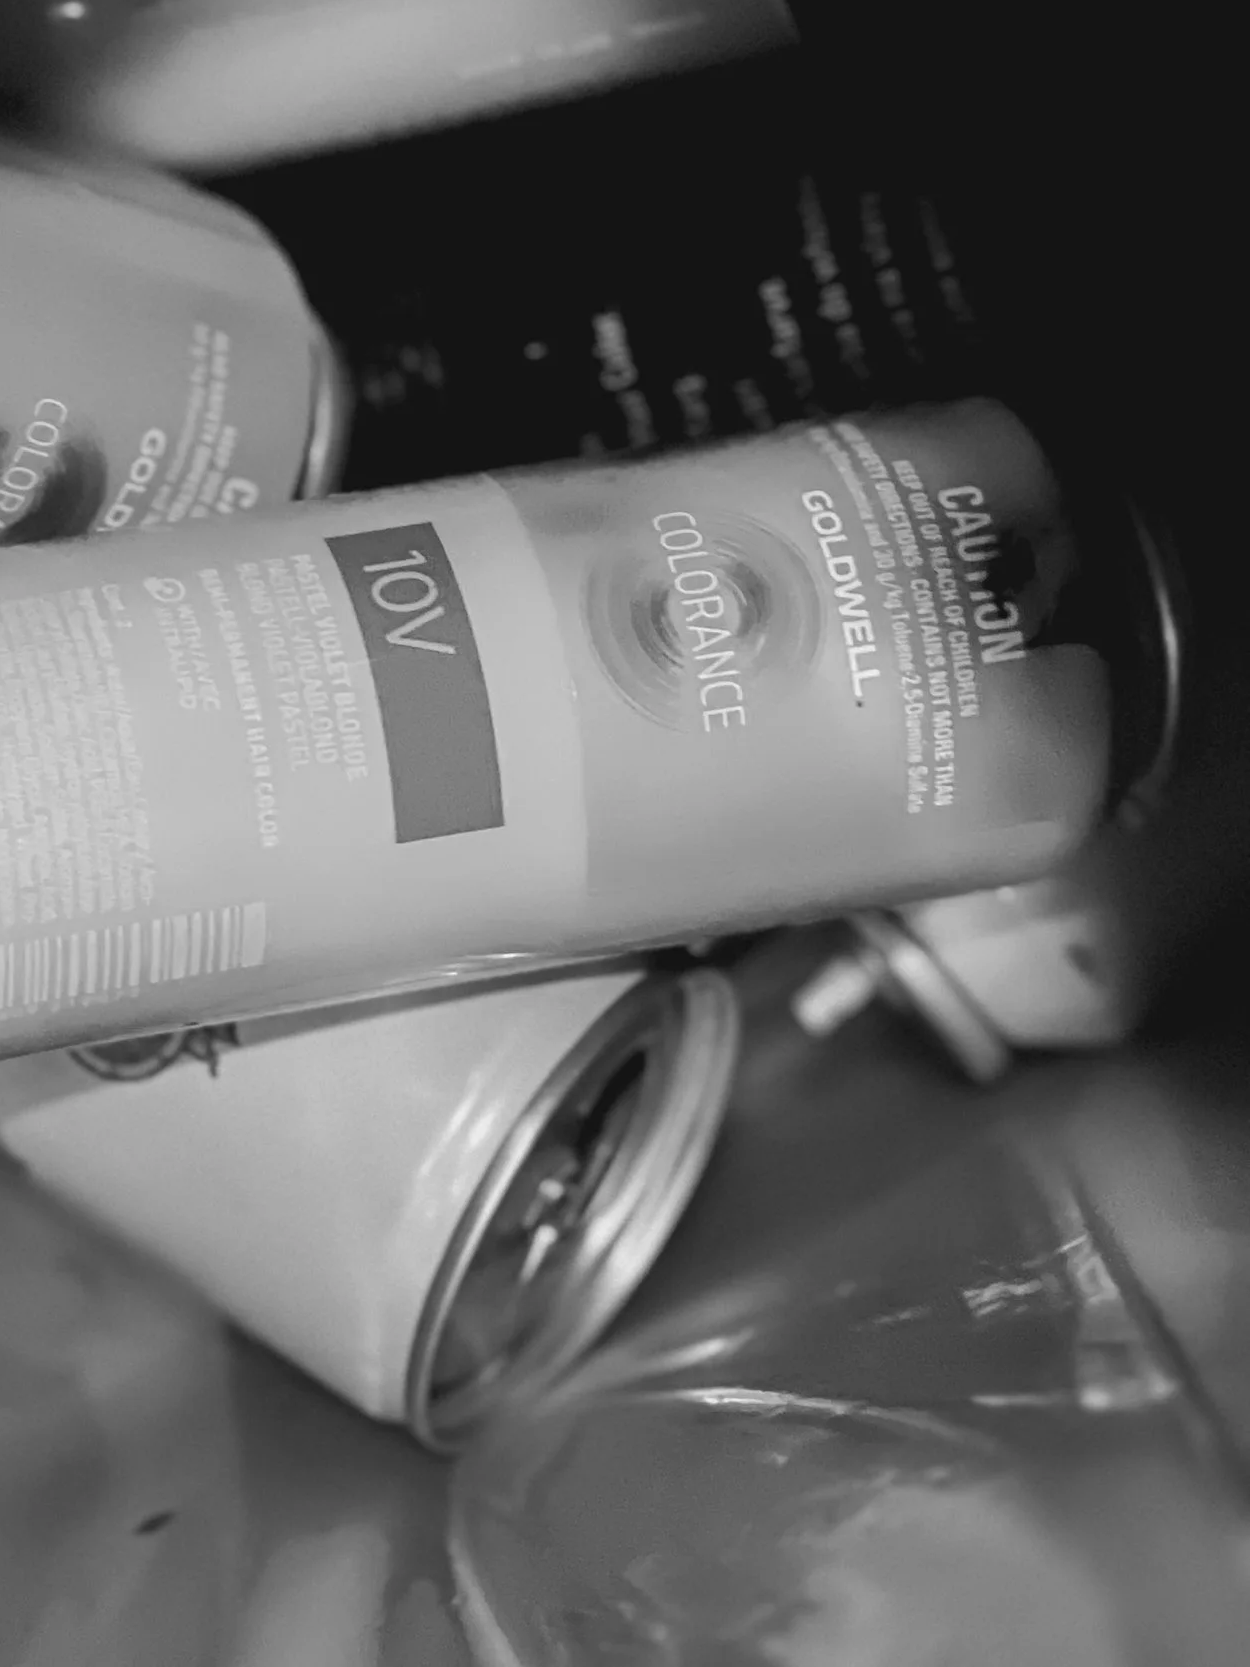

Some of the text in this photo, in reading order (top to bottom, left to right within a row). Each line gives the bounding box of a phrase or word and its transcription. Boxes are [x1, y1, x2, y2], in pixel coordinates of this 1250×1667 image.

[100, 427, 165, 531] GOLD
[908, 492, 935, 520] OUT
[919, 523, 944, 541] OF
[361, 548, 456, 656] 10V
[928, 547, 960, 601] REACH
[936, 486, 1027, 663] CAUON
[653, 510, 747, 732] COLORANCE
[910, 578, 945, 667] CONTAINS
[943, 603, 964, 626] OF
[236, 563, 310, 772] BLOND VIOLET PASTEL
[291, 554, 369, 781] PASTEL VIOLET BLONDE
[928, 669, 951, 705] NOT
[948, 629, 979, 718] CHILDREN
[246, 727, 271, 778] HAIR
[932, 708, 956, 760] MORE
[257, 781, 279, 849] COLOR
[933, 762, 954, 807] THAN
